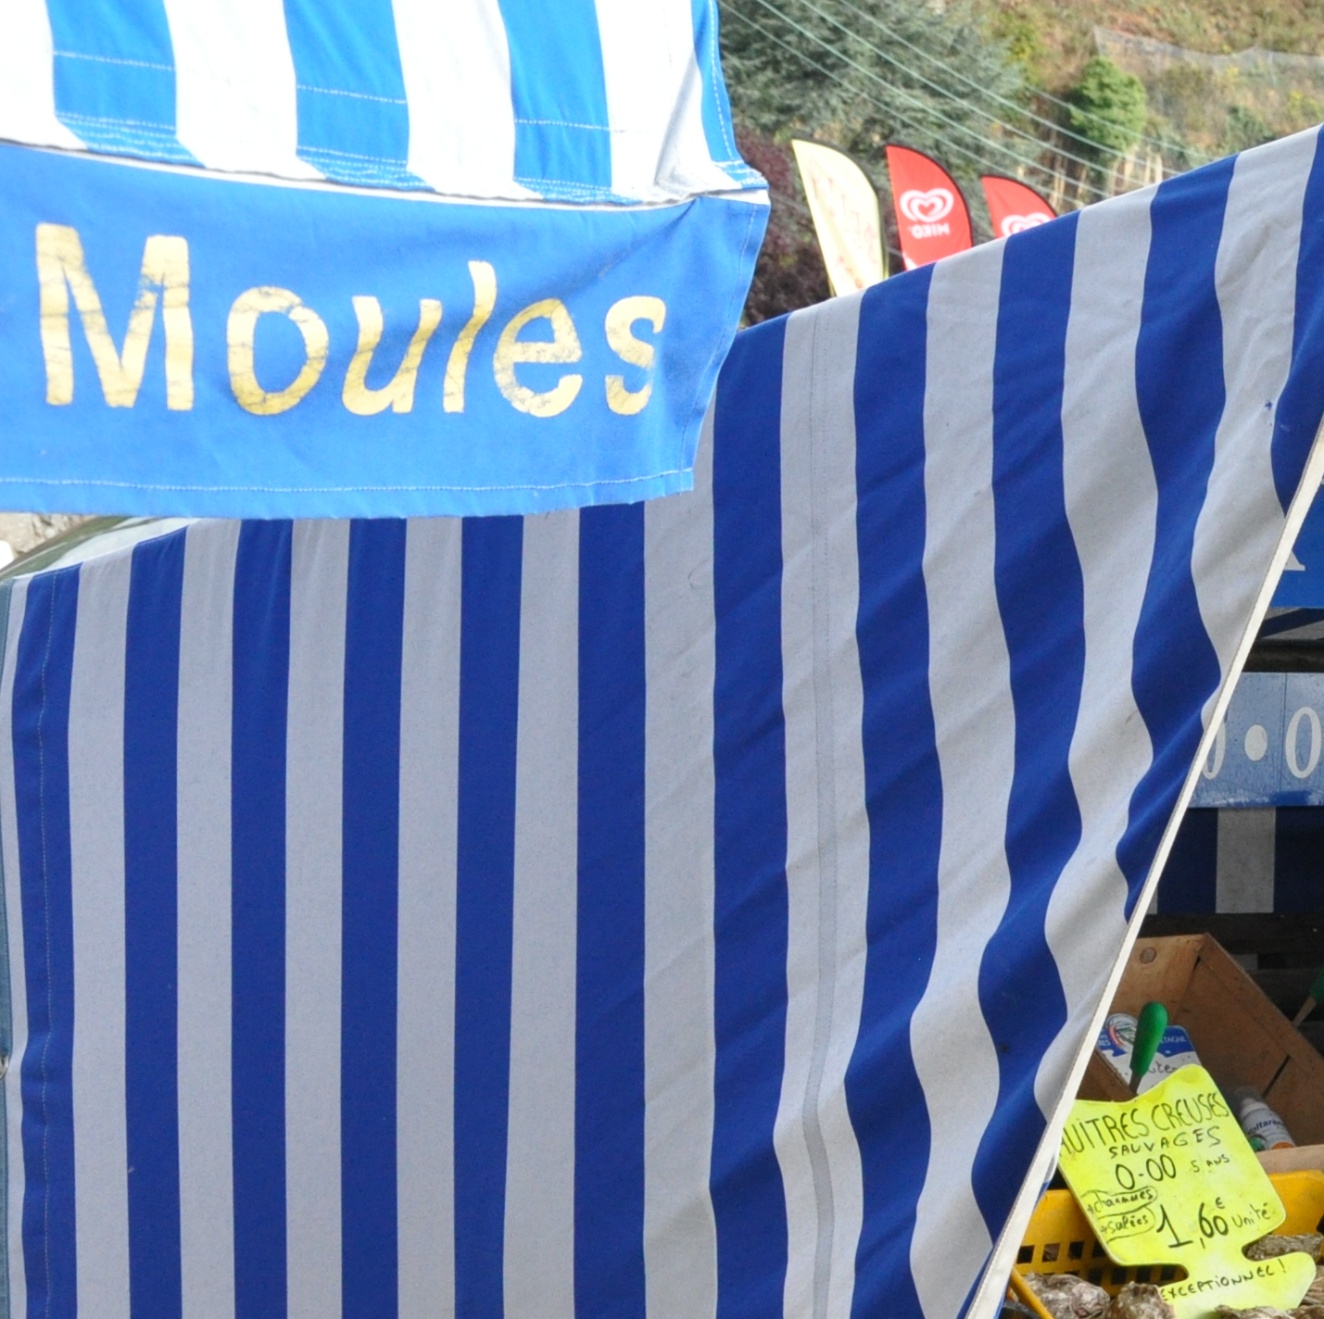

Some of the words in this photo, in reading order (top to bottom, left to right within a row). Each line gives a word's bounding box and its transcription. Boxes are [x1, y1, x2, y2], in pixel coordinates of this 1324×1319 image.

[35, 222, 666, 417] Moules
[1151, 1093, 1230, 1131] CREUSES
[1109, 1125, 1221, 1159] SAUVAGES
[1231, 1202, 1271, 1229] Unité
